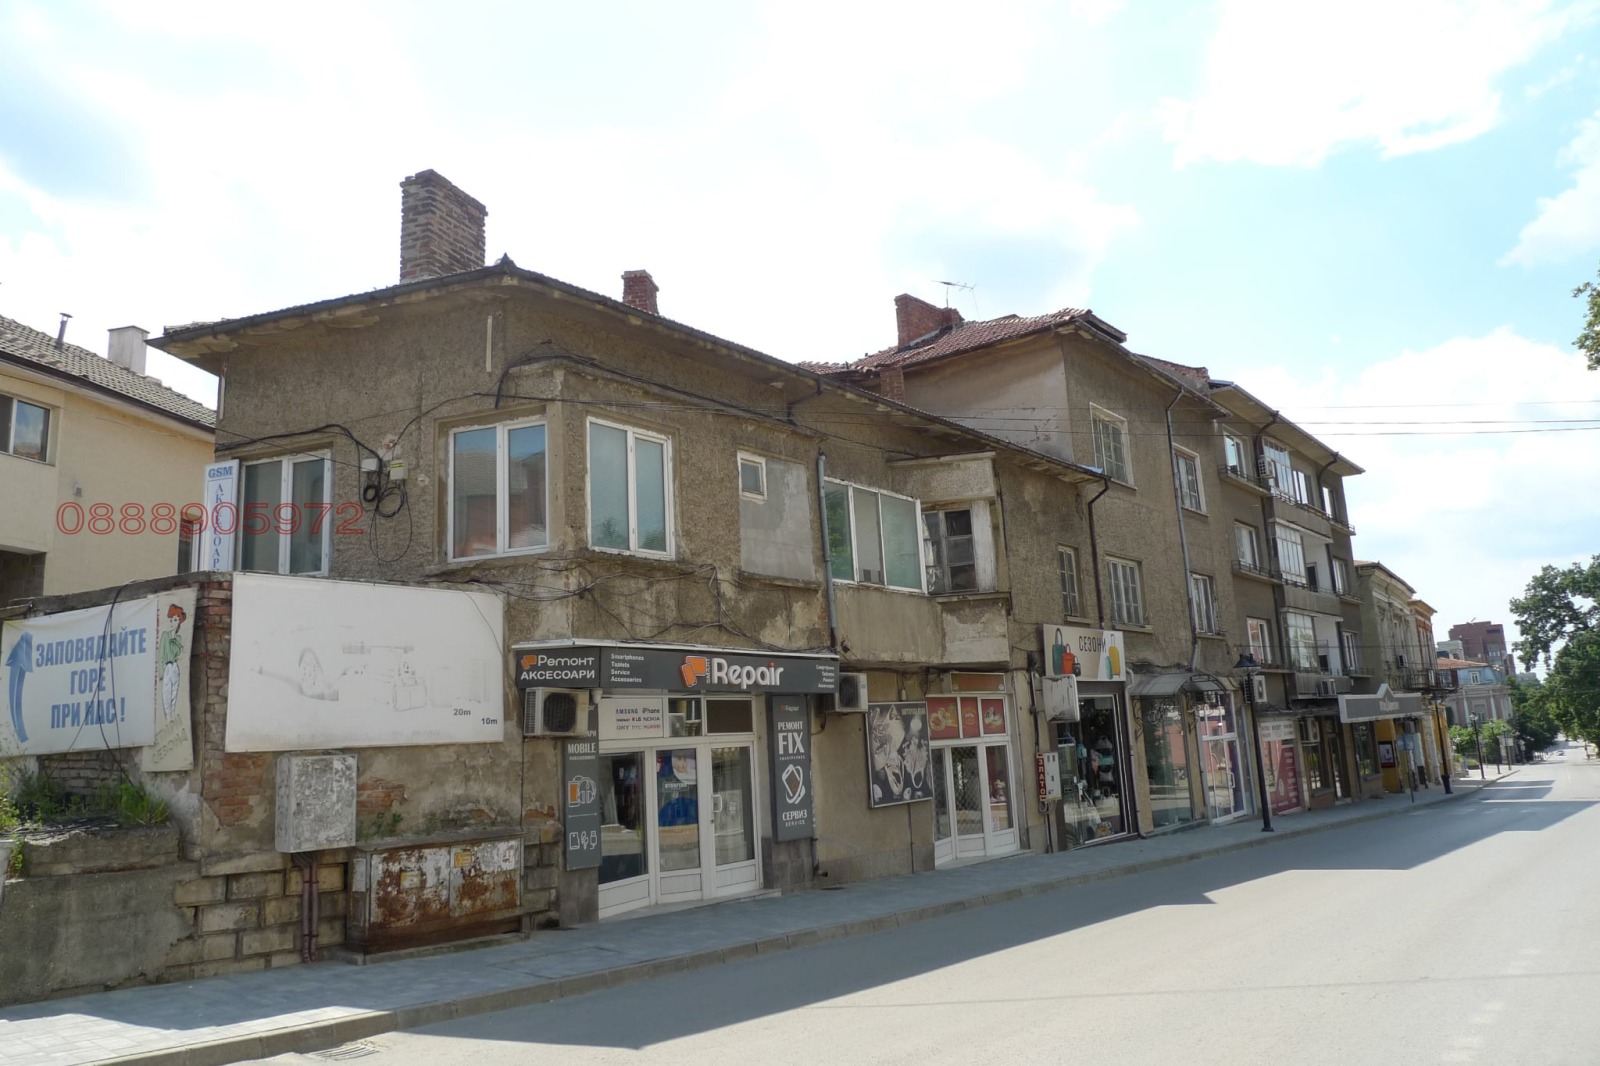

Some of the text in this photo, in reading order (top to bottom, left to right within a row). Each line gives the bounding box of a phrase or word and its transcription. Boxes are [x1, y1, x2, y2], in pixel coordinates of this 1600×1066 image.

[208, 466, 232, 478] GSM
[212, 484, 224, 572] АКСЕСОАР
[36, 626, 147, 668] ЗАПОВЯДАЙТЕ
[1079, 635, 1107, 653] СЕЗОНИ
[538, 654, 595, 667] Ремонт
[70, 667, 106, 695] ГОРЕ
[520, 669, 595, 681] АКСЕСОАРИ
[711, 657, 784, 690] Repair
[51, 702, 81, 729] ПРИ
[481, 717, 498, 725] 10m
[777, 721, 803, 731] РЕМОНТ
[567, 742, 597, 754] MOBILE
[778, 732, 805, 755] FIX
[782, 809, 808, 821] СЕРВИЗ
